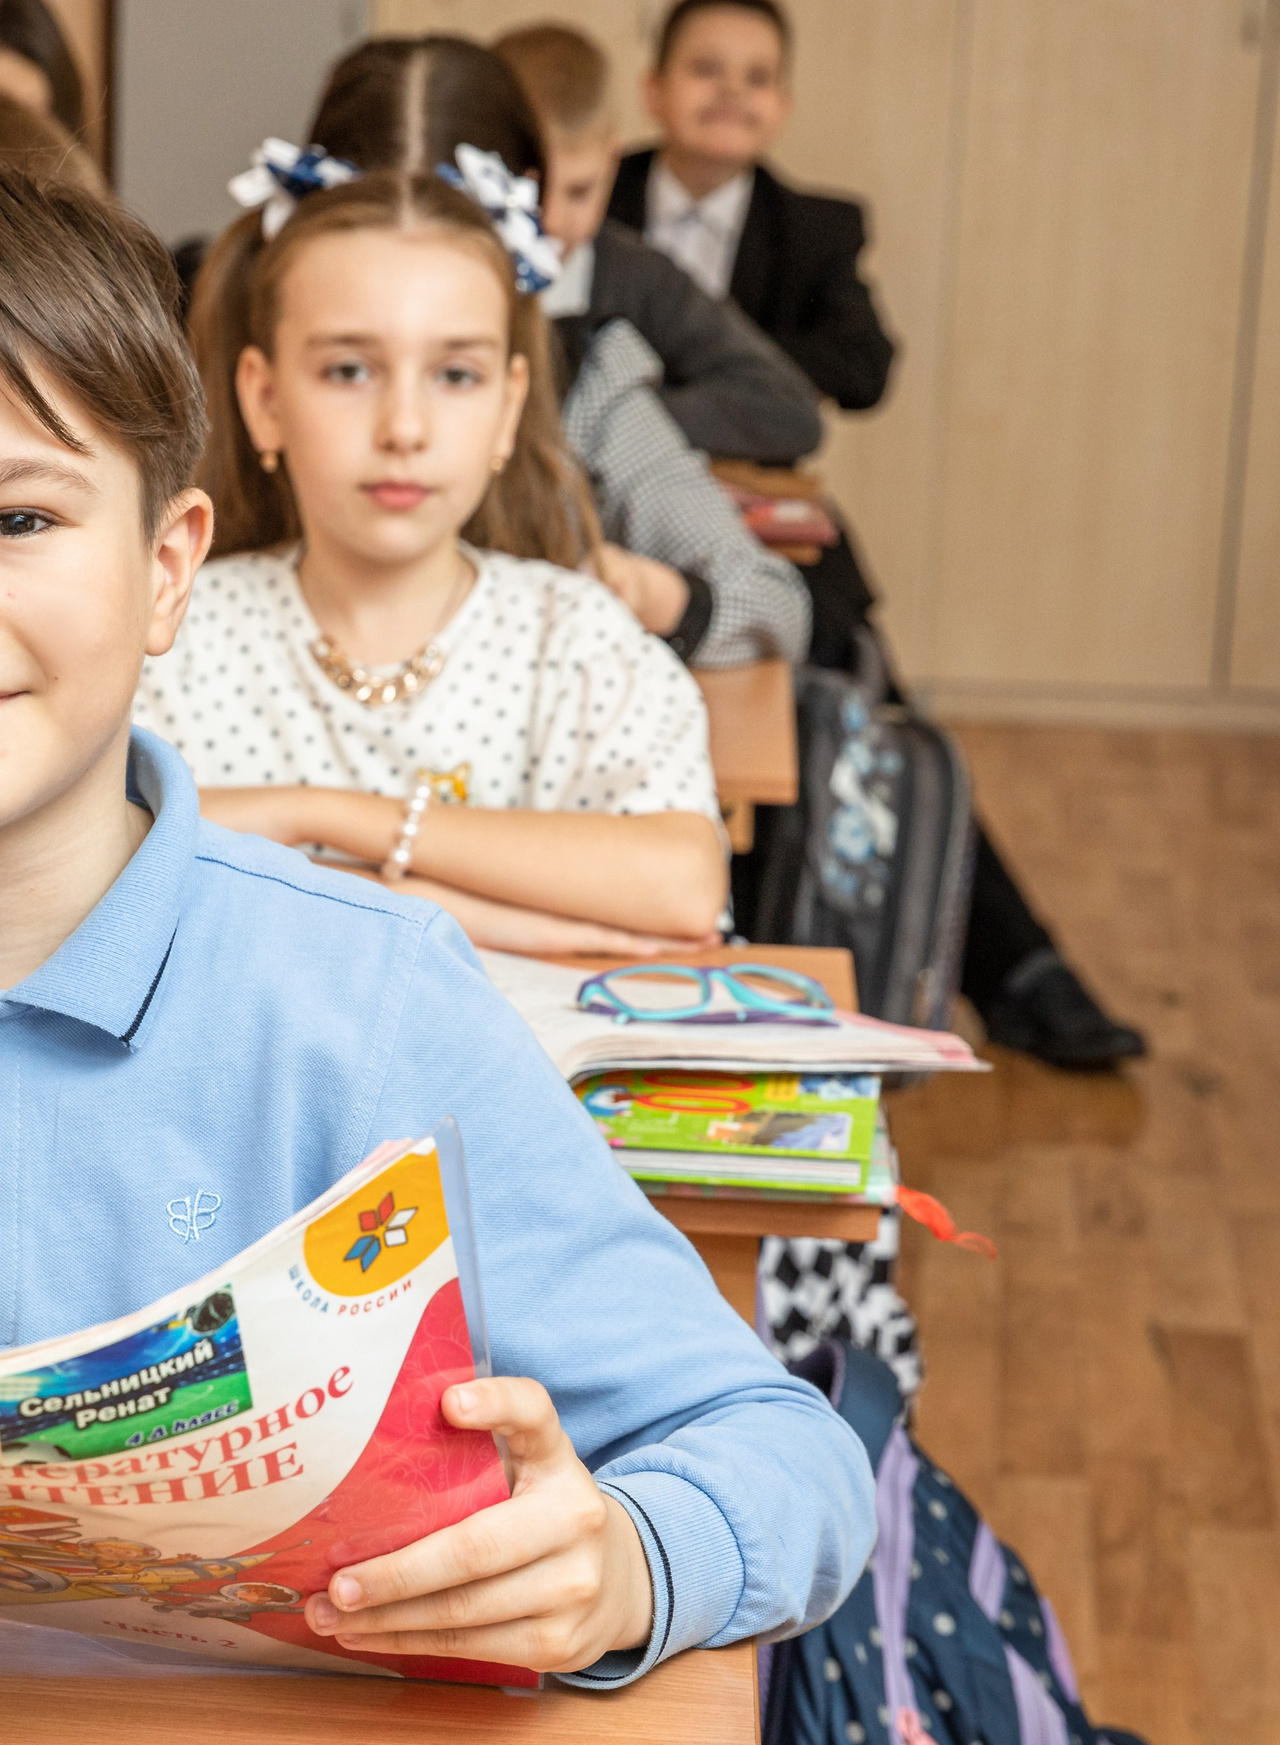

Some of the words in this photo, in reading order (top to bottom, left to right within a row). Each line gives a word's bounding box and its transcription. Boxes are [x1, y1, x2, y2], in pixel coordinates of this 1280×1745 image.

[288, 1263, 329, 1313] ШКОЛА
[337, 1279, 412, 1316] РОССИИ
[19, 1338, 215, 1418] Сельницкий
[74, 1386, 172, 1430] Ренат
[125, 1432, 143, 1448] 4
